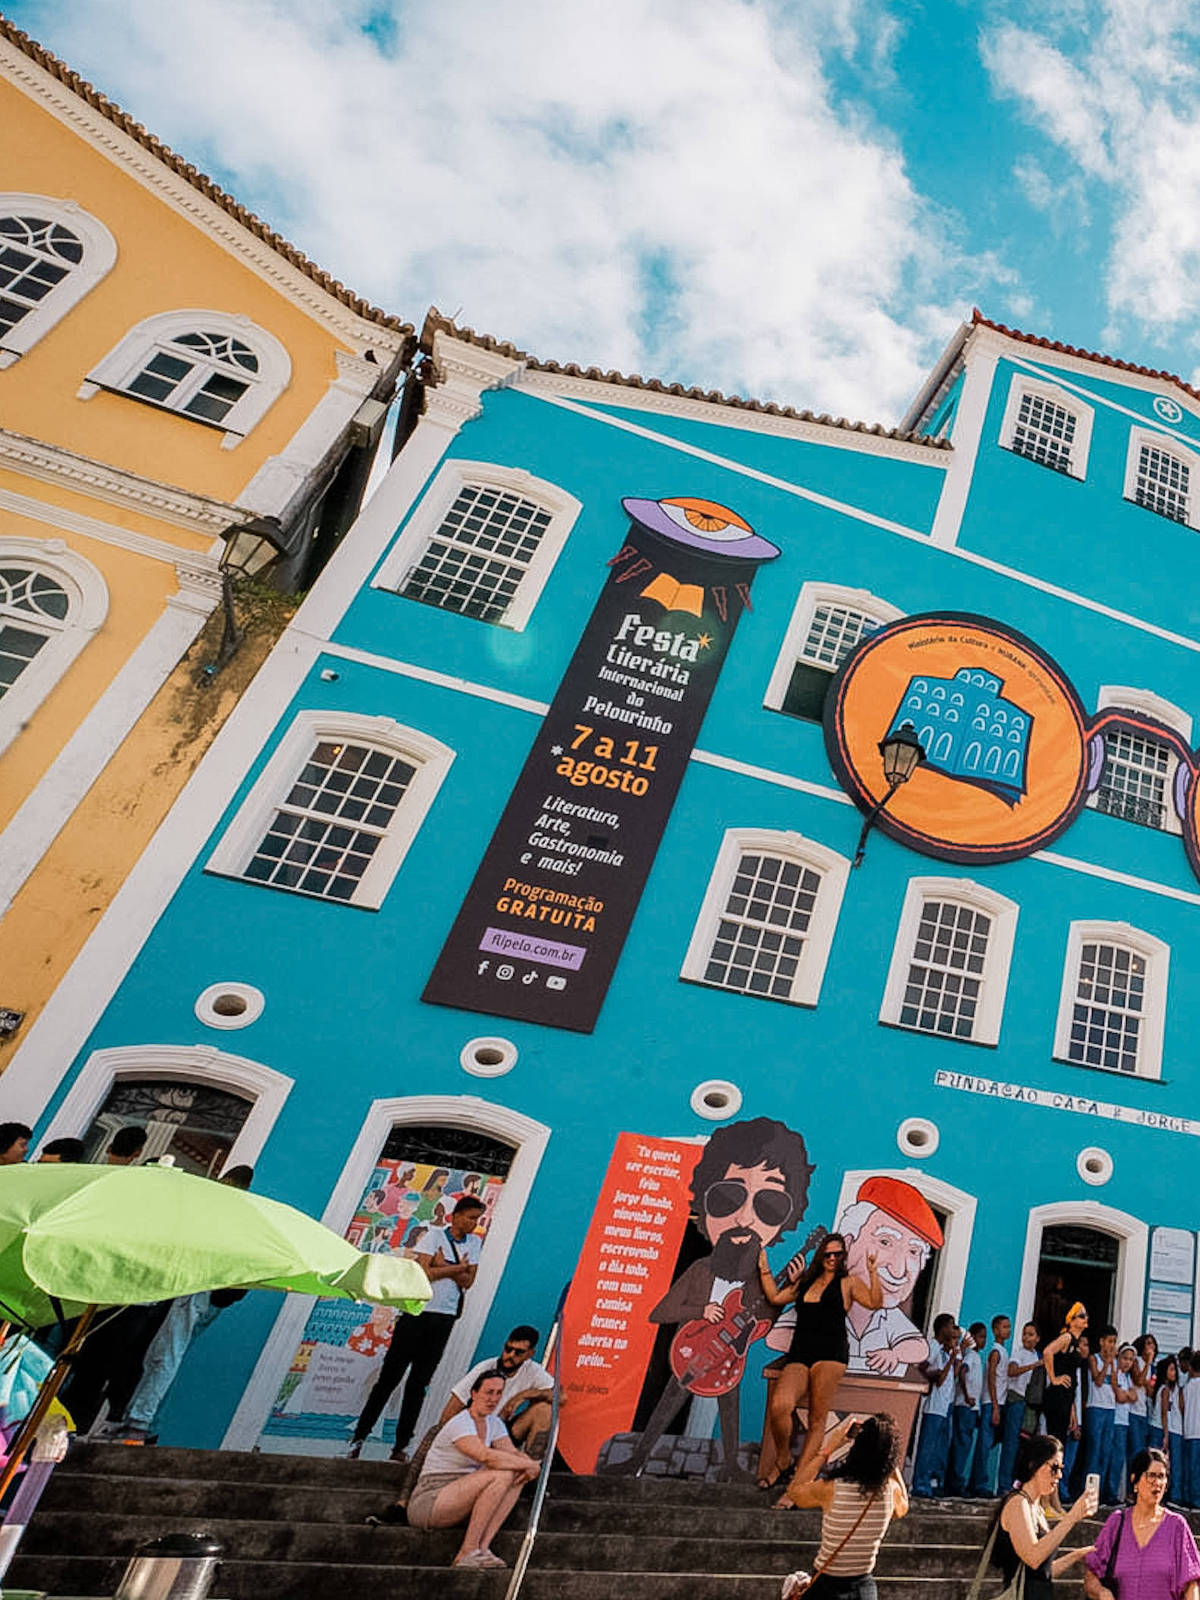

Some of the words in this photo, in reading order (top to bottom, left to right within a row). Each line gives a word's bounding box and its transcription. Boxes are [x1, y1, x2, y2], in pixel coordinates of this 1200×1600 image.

[613, 613, 700, 662] Festa
[606, 644, 690, 686] Literária
[598, 665, 685, 702] Internacional
[625, 691, 645, 708] do
[582, 695, 674, 735] Pelourinho
[570, 723, 594, 751] 7
[594, 736, 615, 759] a
[619, 740, 659, 772] 11
[555, 755, 650, 797] agosto
[533, 813, 572, 837] Arte,
[542, 795, 621, 830] Literatura,
[520, 852, 533, 865] e
[537, 856, 583, 876] mais!
[528, 831, 625, 867] Gastronomia
[503, 877, 604, 913] Programação
[495, 896, 597, 933] GRATUITA
[491, 933, 577, 962] flipelo.com.br
[1136, 1111, 1191, 1133] JORGE
